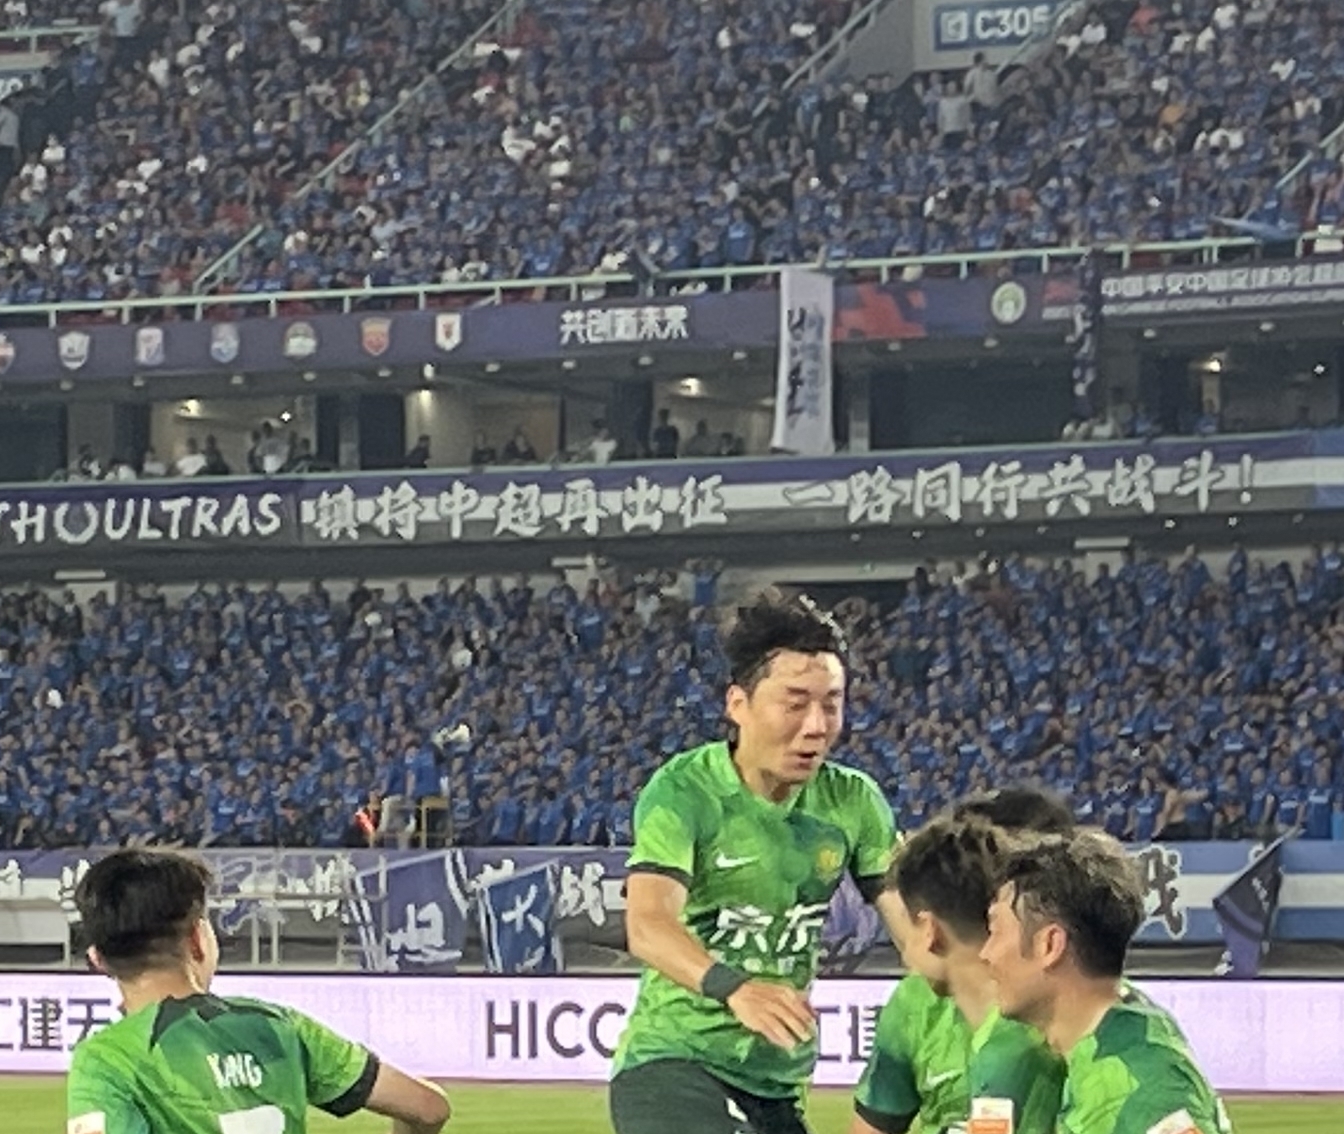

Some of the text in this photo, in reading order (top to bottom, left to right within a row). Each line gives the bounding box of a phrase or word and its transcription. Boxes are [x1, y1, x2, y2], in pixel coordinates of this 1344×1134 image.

[560, 305, 689, 345] 共创新未来
[103, 493, 282, 542] ULTRAS
